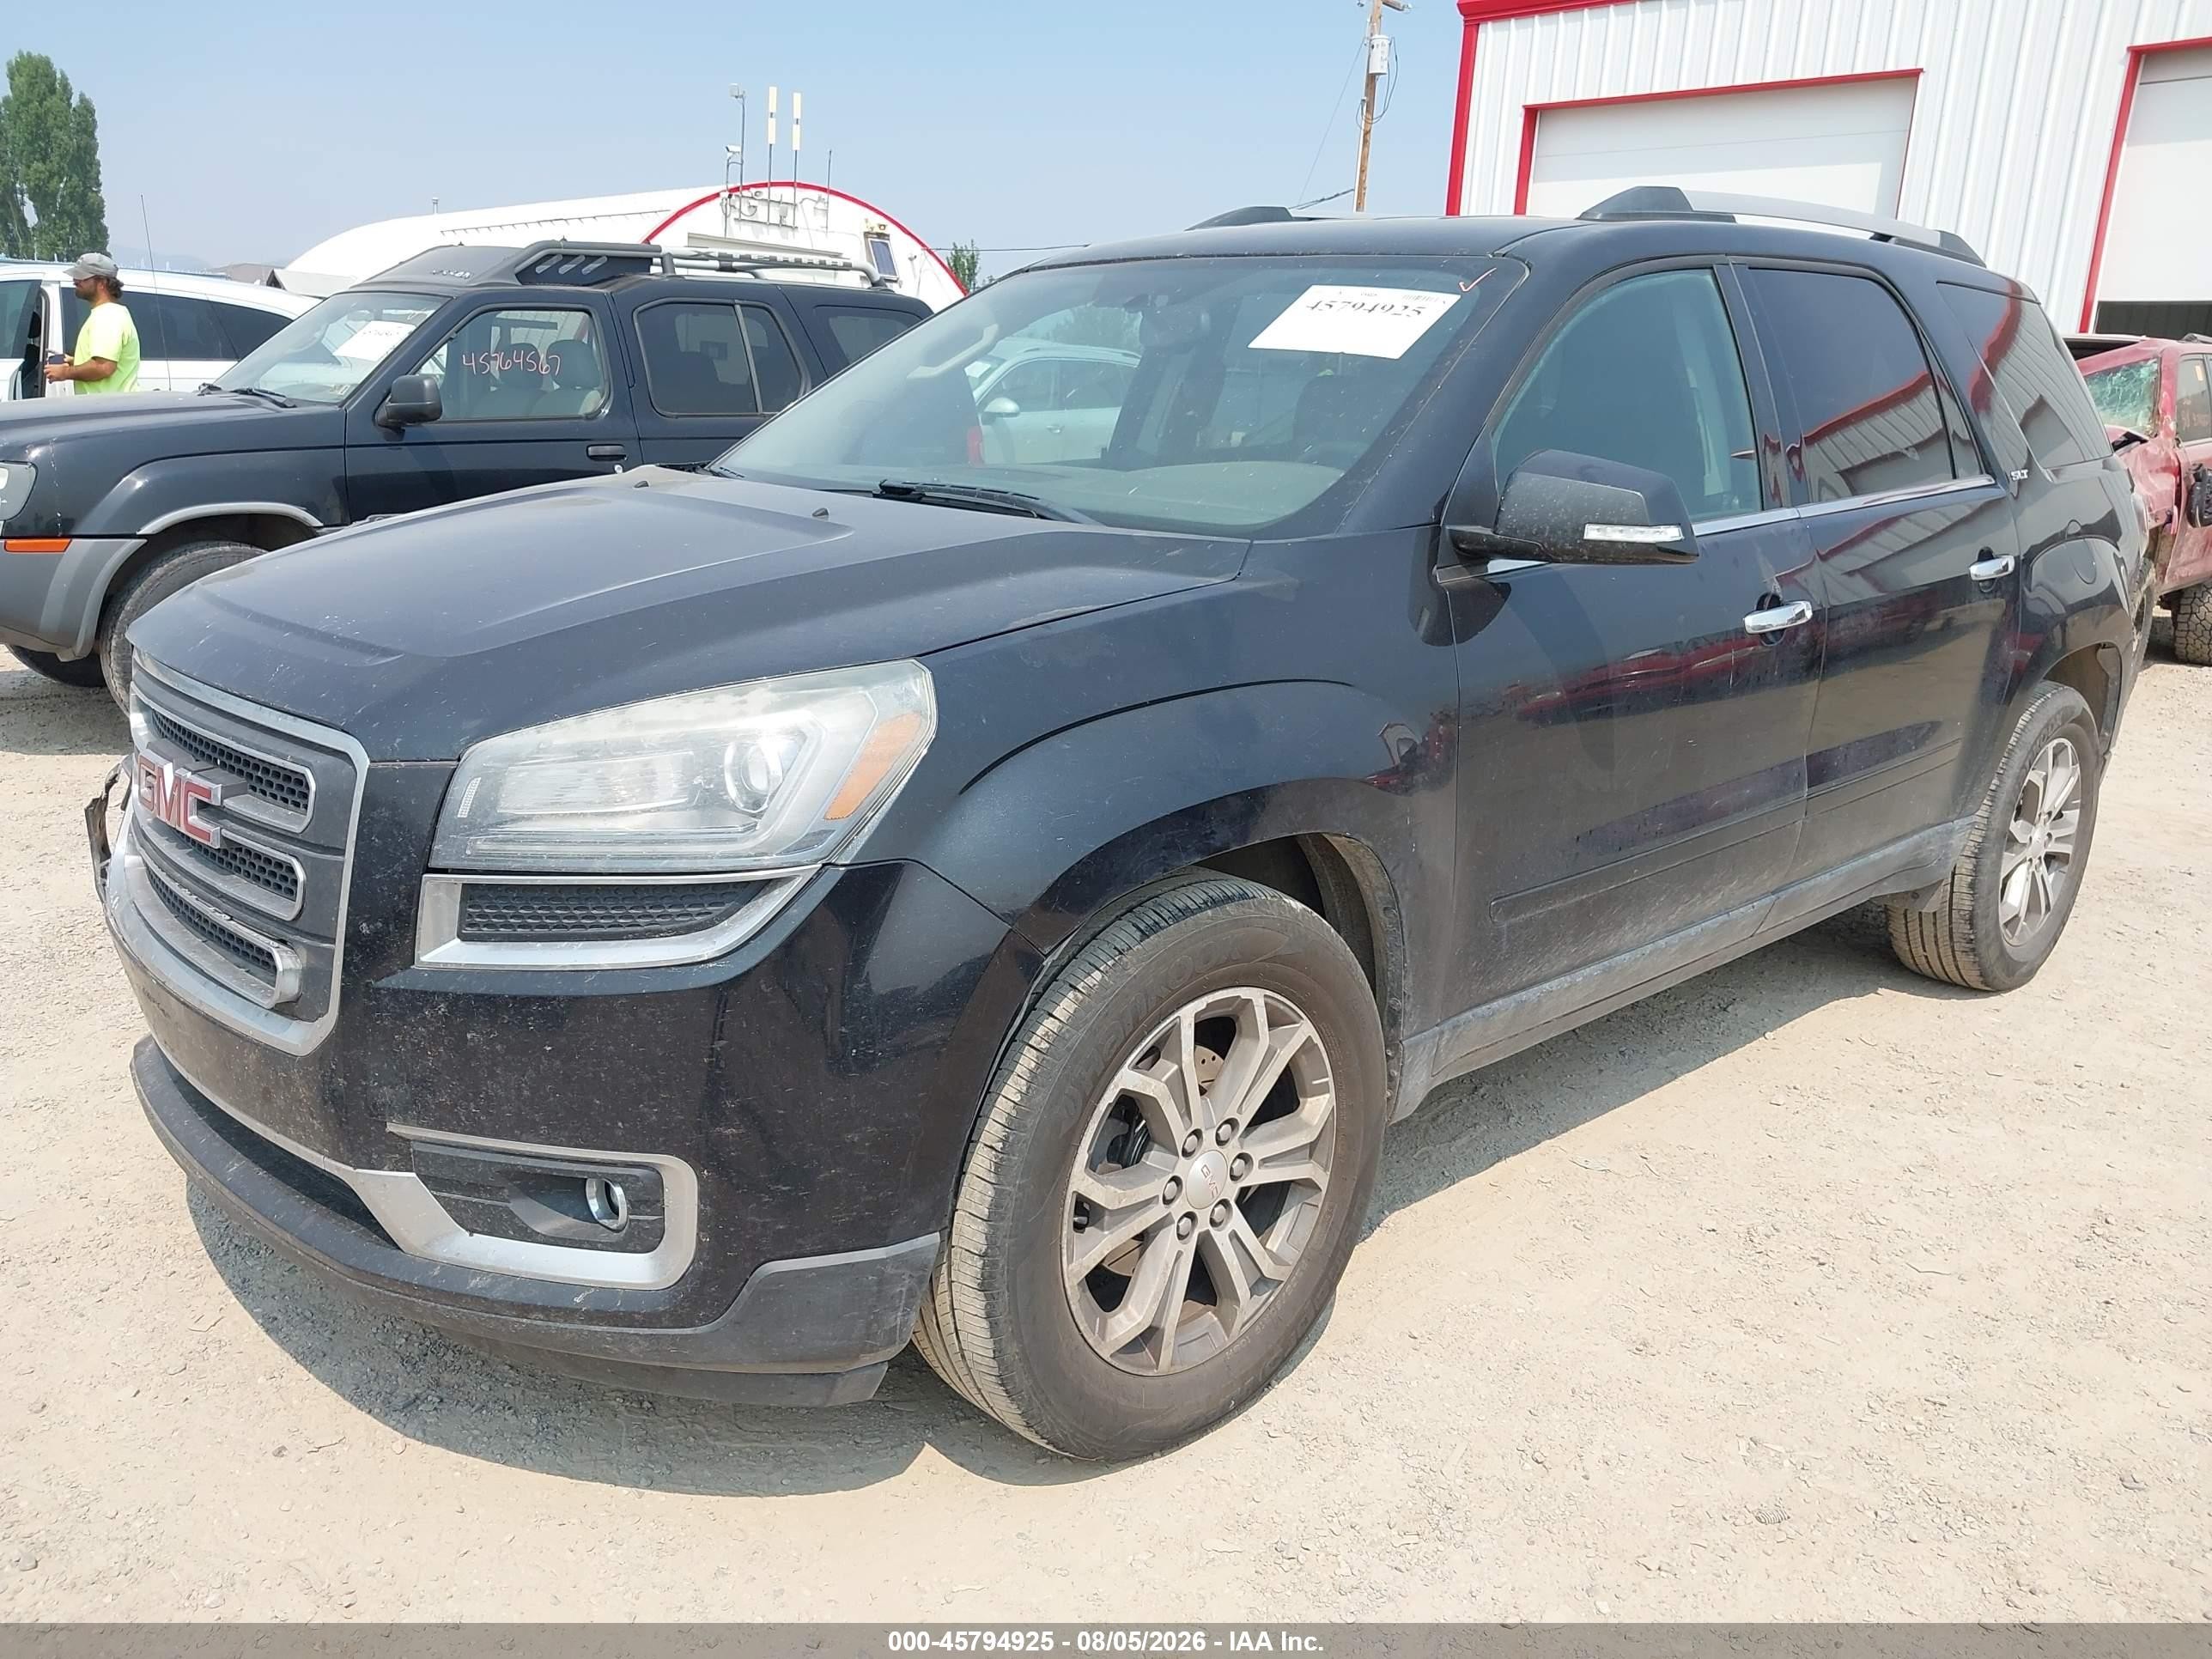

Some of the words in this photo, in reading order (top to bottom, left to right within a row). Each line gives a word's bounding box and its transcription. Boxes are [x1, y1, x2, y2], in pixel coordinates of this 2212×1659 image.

[1305, 300, 1427, 317] 45794925
[461, 349, 562, 375] 45764567
[2010, 469, 2028, 481] SLT
[137, 749, 222, 848] GMC
[1200, 1164, 1218, 1199] GMC
